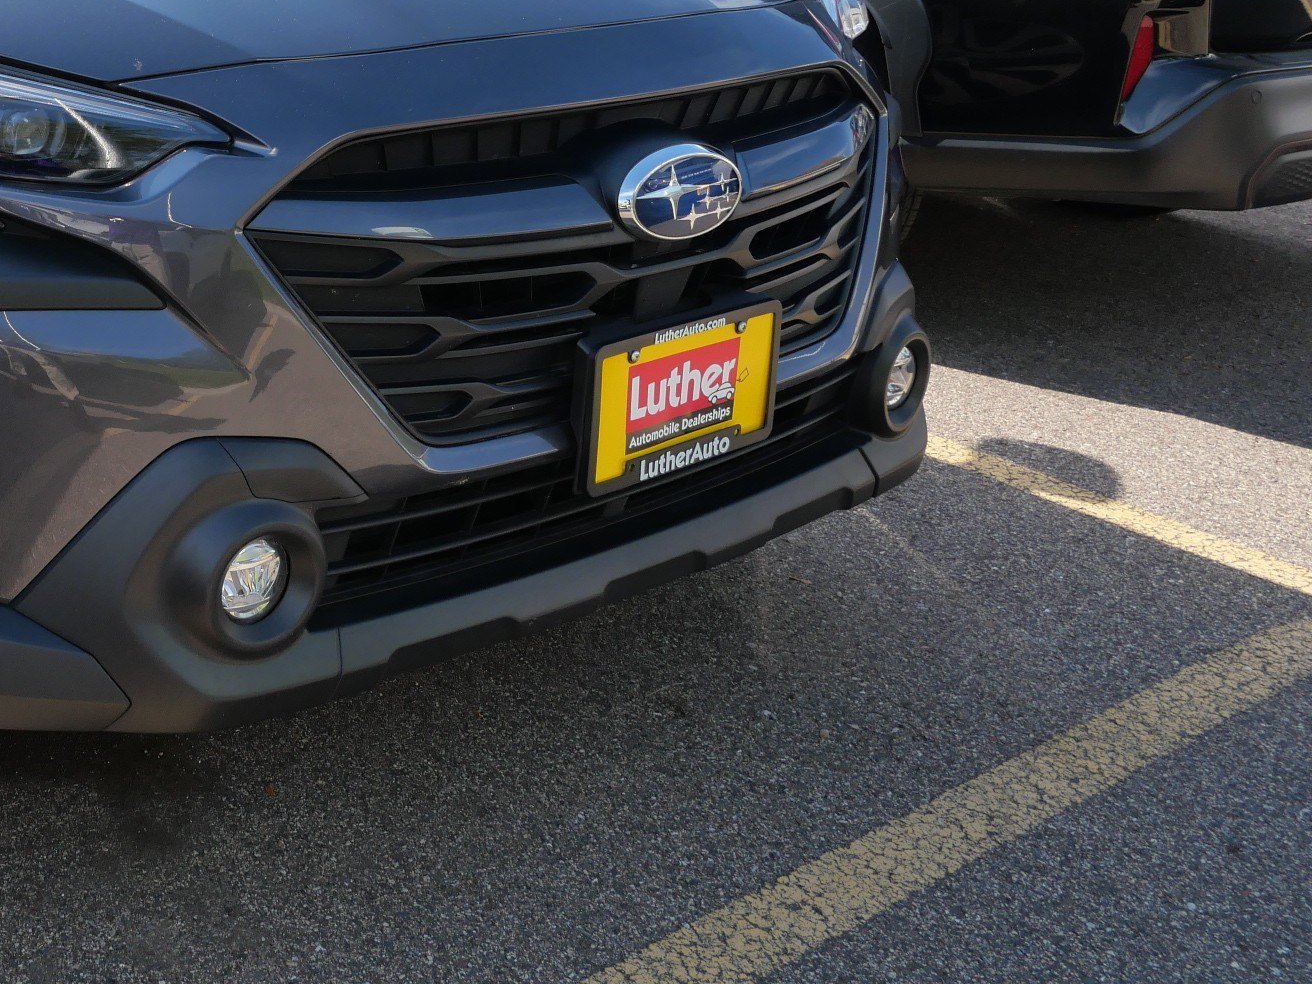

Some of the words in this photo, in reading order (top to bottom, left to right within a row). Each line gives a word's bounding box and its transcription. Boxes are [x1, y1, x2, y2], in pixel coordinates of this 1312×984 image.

[654, 317, 726, 345] LutherAuto.com
[630, 358, 737, 421] Luther
[628, 421, 680, 449] Automobile
[681, 405, 731, 429] Dealerships
[639, 435, 730, 482] LutherAuto
